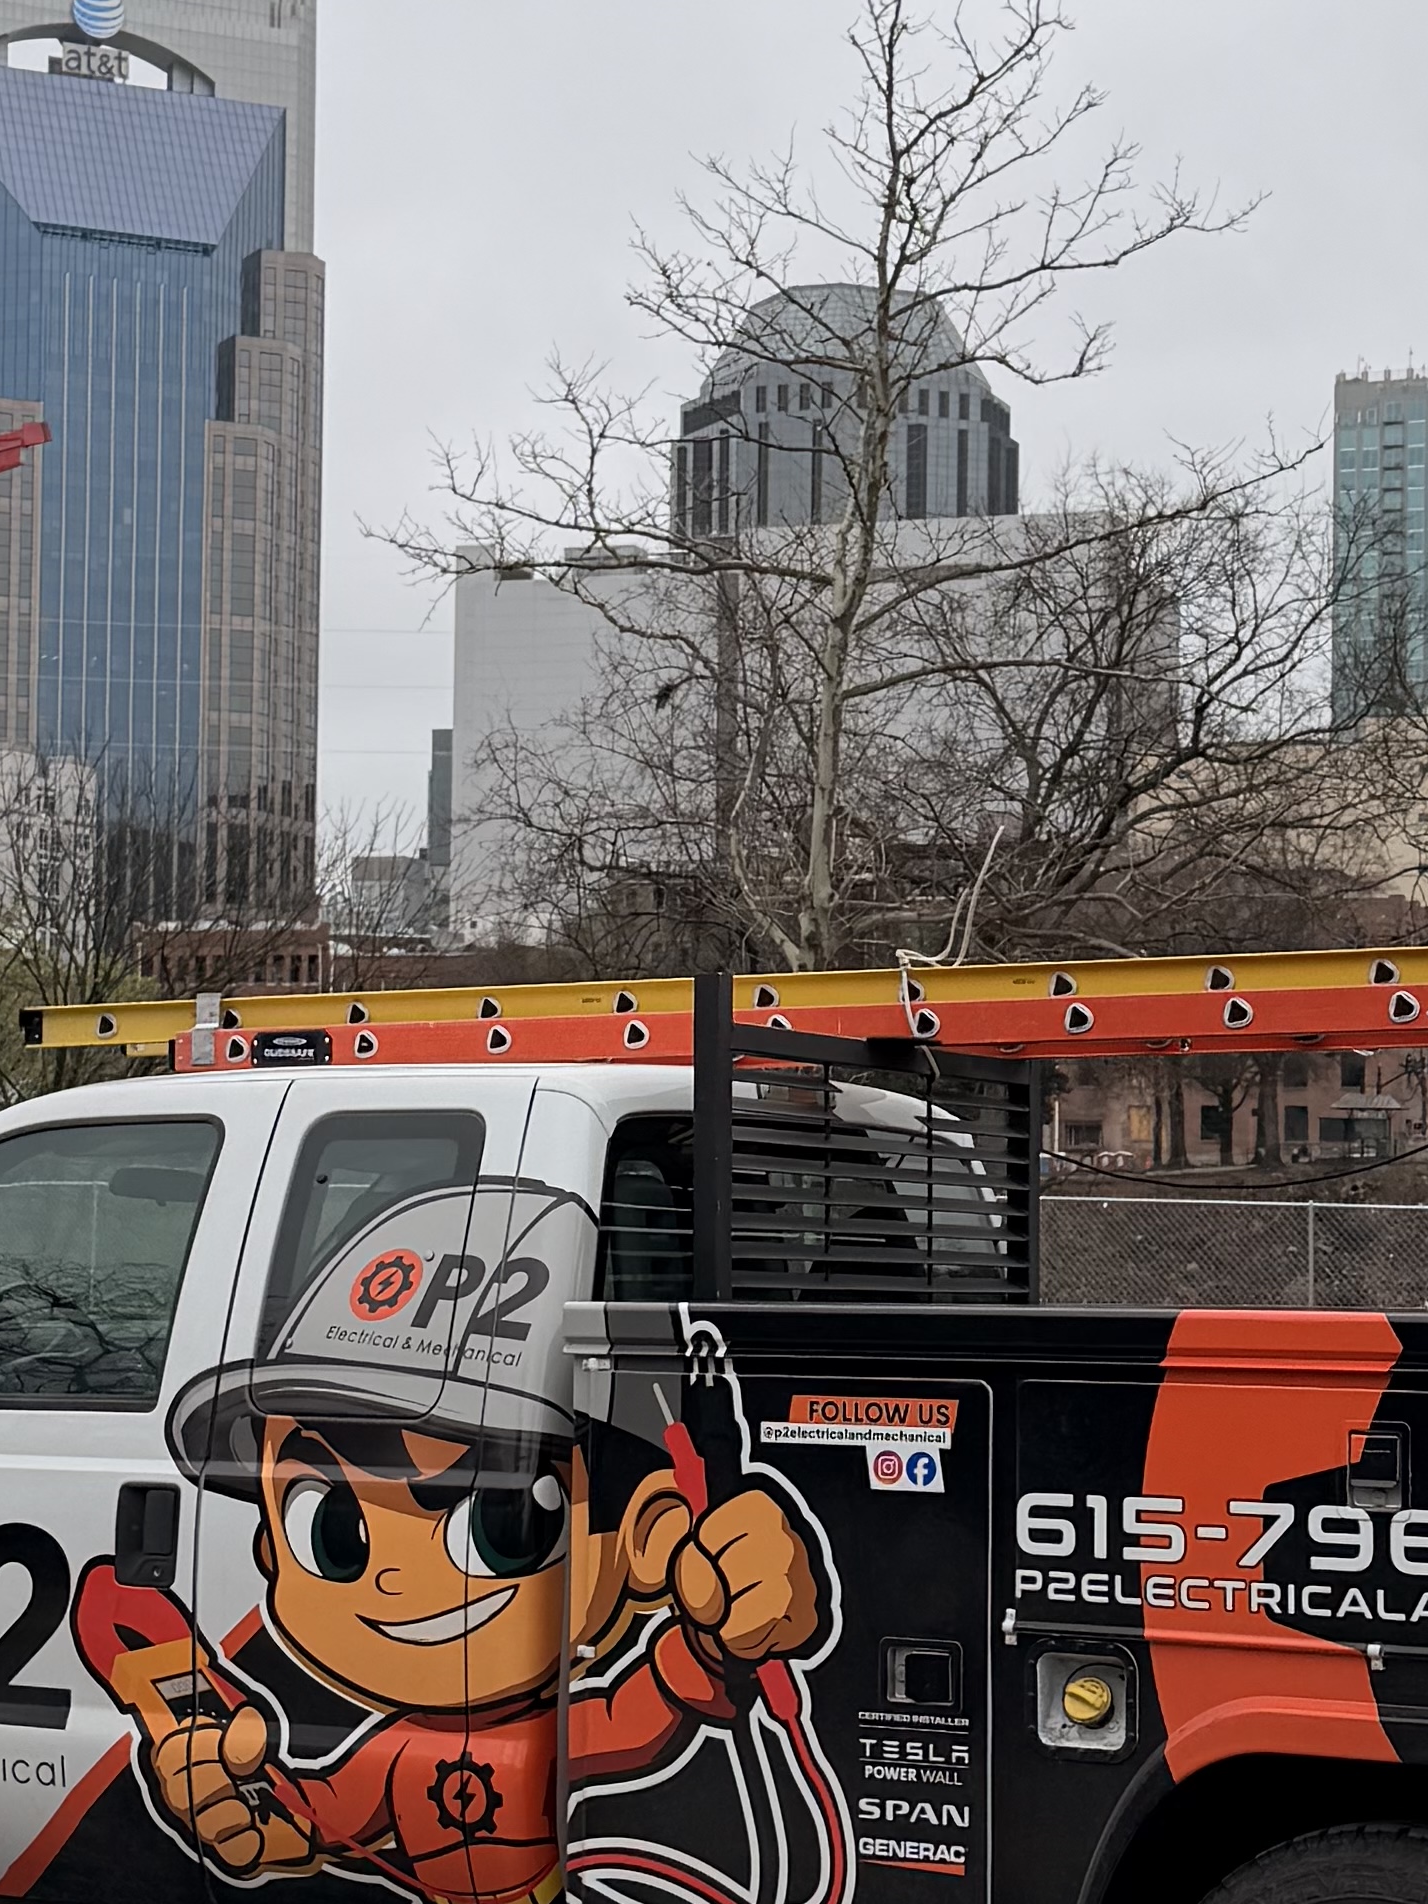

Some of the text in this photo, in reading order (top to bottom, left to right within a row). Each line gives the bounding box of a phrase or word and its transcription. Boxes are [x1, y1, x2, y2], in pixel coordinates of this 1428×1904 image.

[65, 46, 128, 79] at&t
[410, 1253, 550, 1342] P2
[325, 1325, 400, 1350] Electrical
[402, 1336, 413, 1351] &
[808, 1400, 951, 1426] FOLLOW US
[858, 1738, 969, 1764] TESLA
[864, 1765, 964, 1786] POWER WALL
[858, 1797, 970, 1828] SPAN
[858, 1837, 966, 1864] GENERAC
